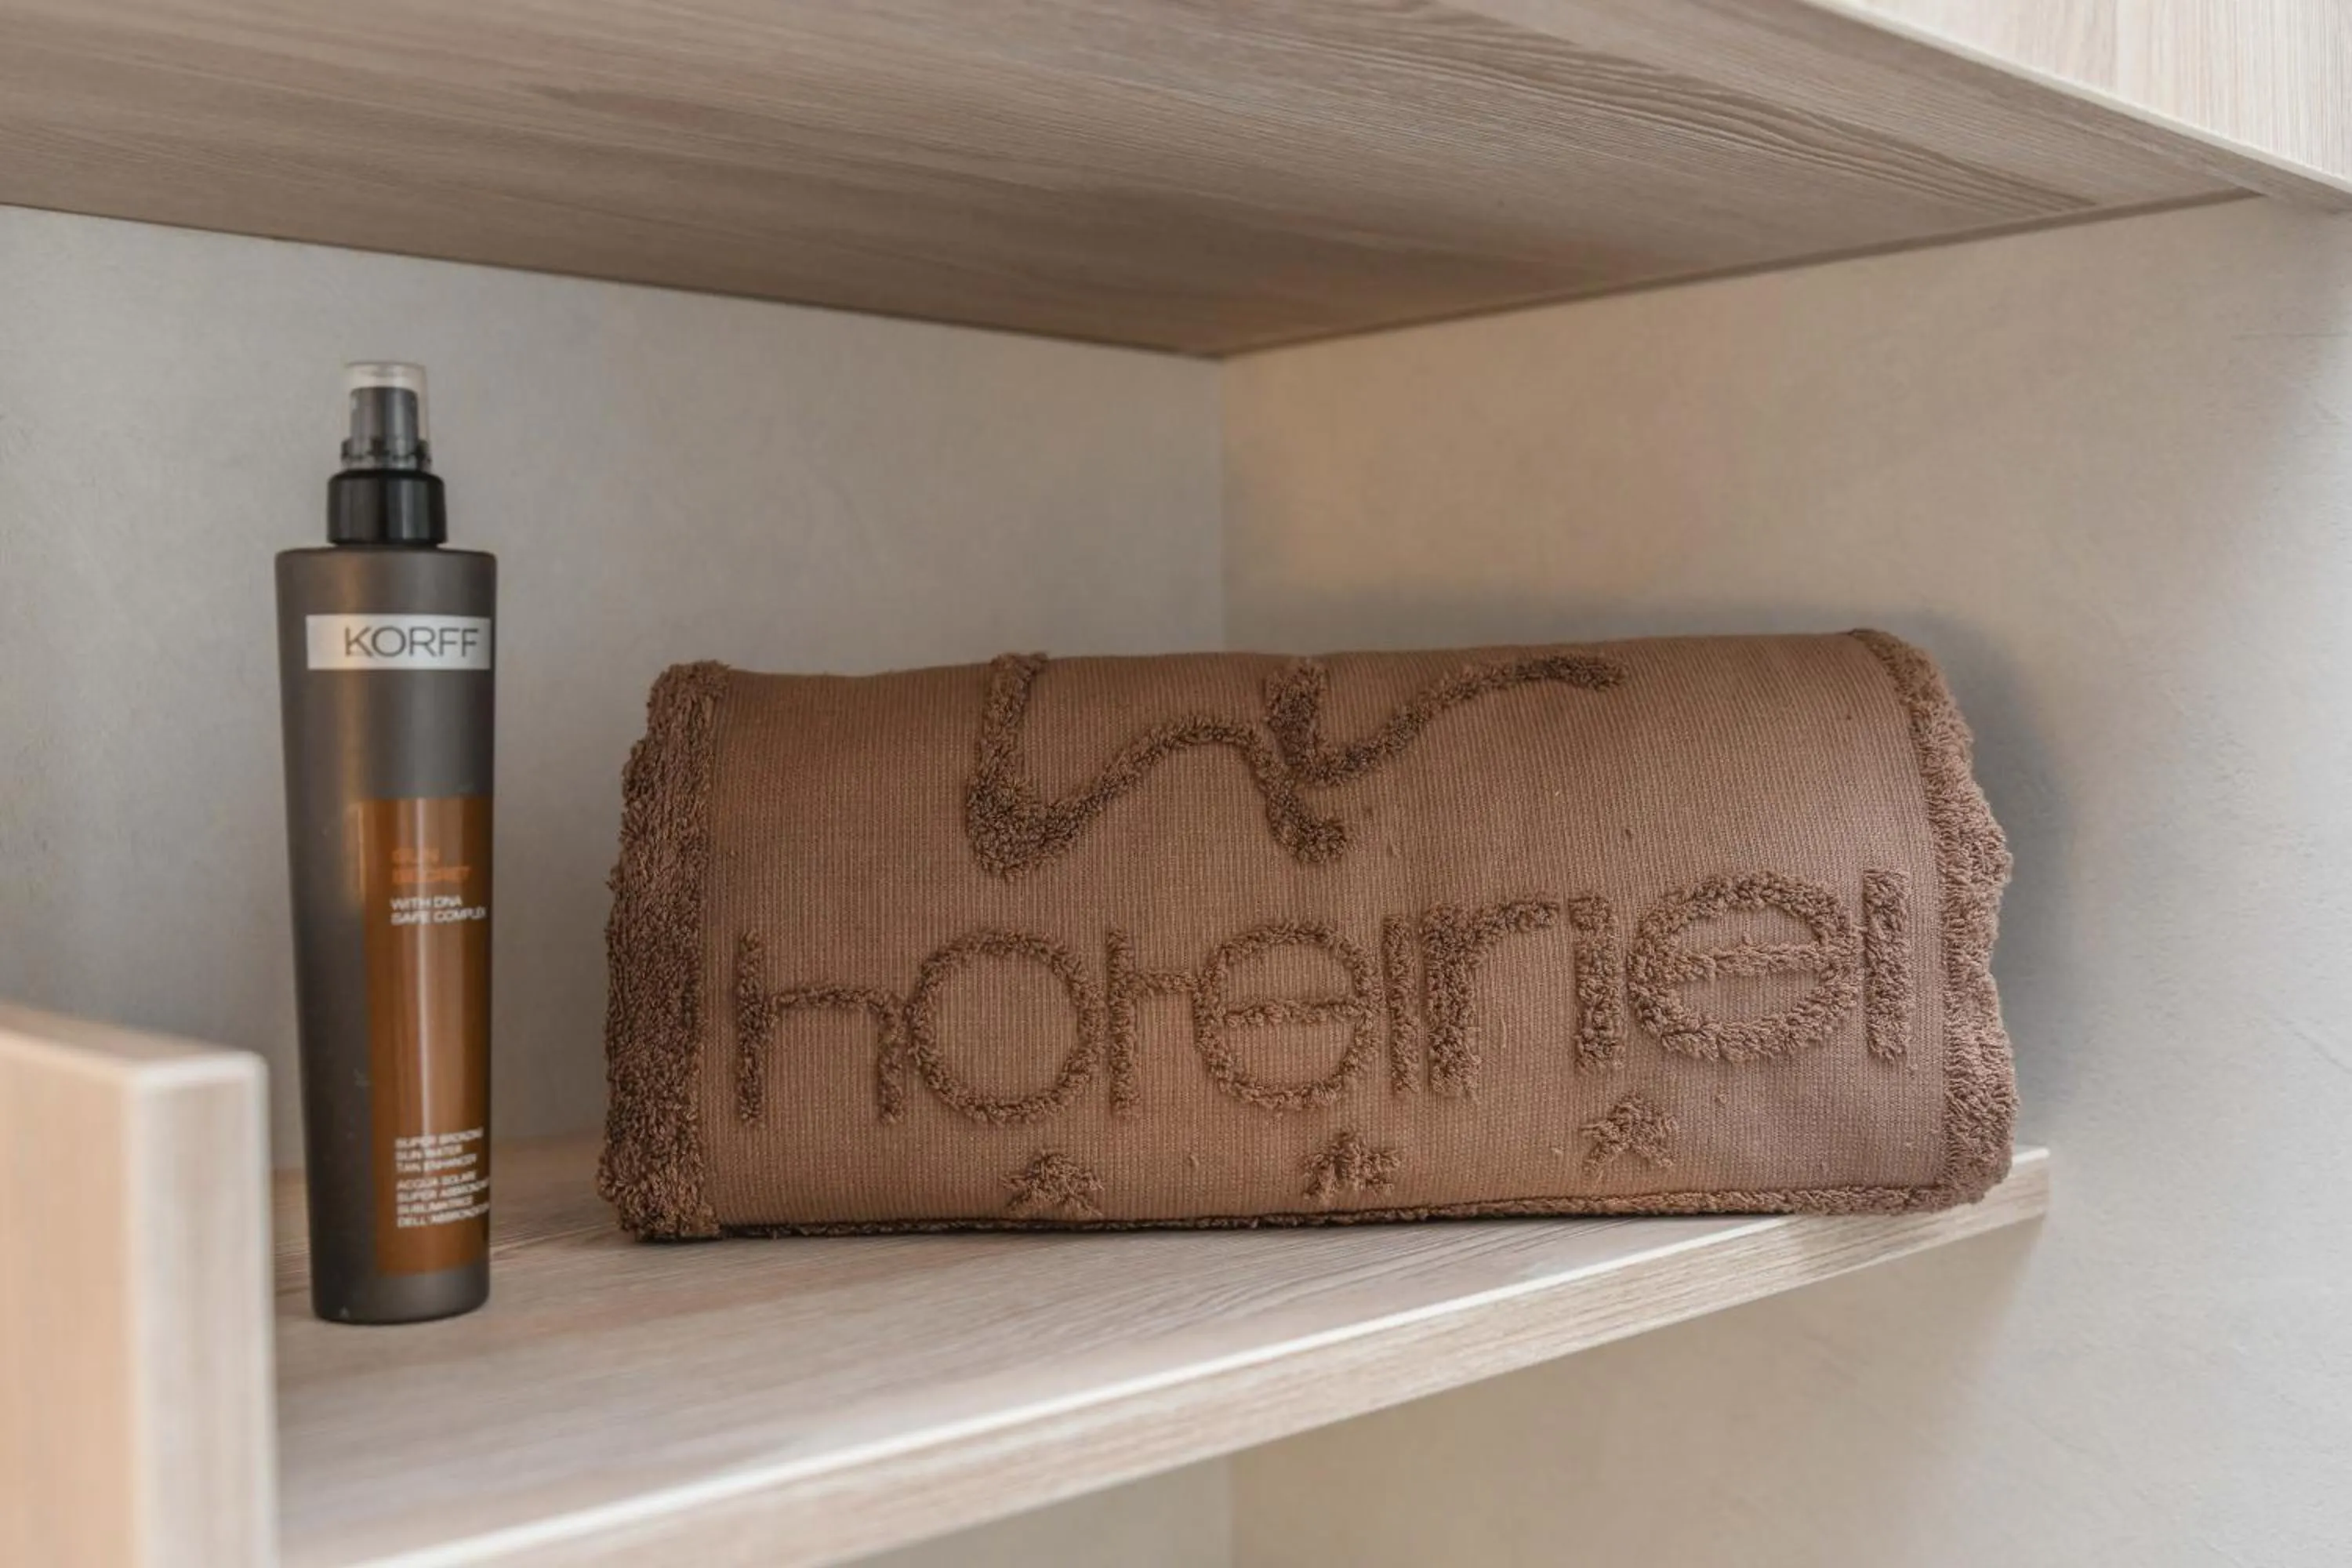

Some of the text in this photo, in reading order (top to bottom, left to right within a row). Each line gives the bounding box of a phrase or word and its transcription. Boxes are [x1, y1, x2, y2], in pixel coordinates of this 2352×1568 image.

[344, 625, 479, 658] KORFF
[390, 895, 463, 910] WITH DNA
[390, 910, 430, 926] SAFE
